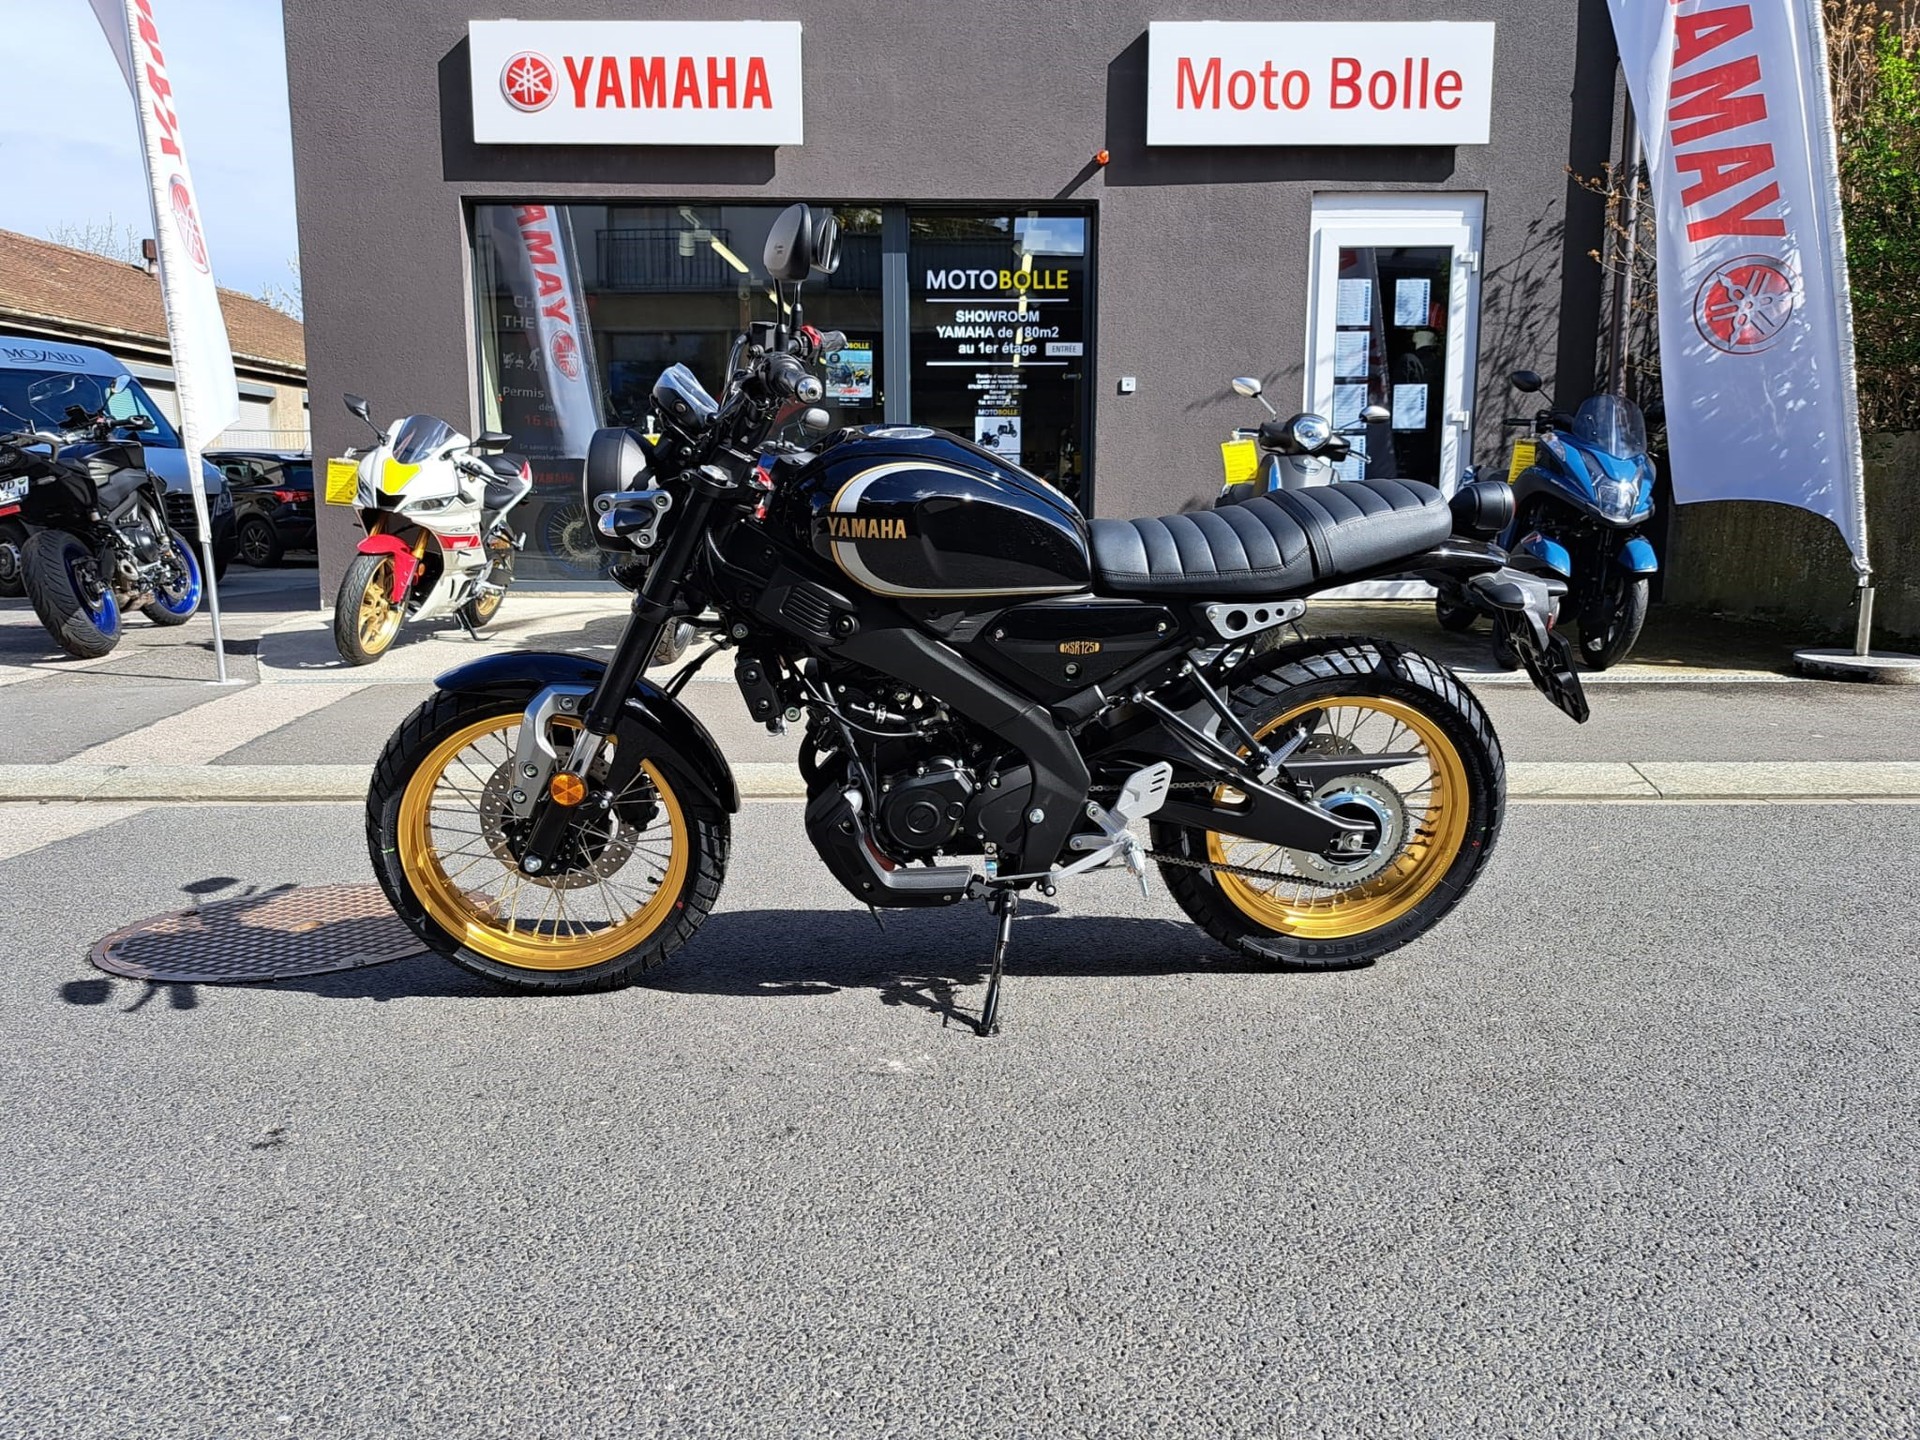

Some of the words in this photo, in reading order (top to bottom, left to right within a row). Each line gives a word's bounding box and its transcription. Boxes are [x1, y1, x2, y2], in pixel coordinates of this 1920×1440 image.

[563, 55, 773, 109] YAMAHA
[1176, 57, 1310, 110] Moto
[1330, 57, 1463, 110] Bolle
[926, 269, 1069, 290] MOTOBOLLE
[502, 315, 535, 329] THE
[955, 310, 1040, 323] SHOWROOM
[936, 326, 995, 338] YAMAHA
[997, 326, 1014, 338] de
[958, 344, 975, 354] au
[977, 342, 999, 354] 1er
[1001, 342, 1037, 356] étage
[1051, 344, 1078, 354] ENTRÉE
[1, 348, 86, 366] MOYARD
[503, 386, 545, 399] Permis
[525, 414, 541, 426] 16
[827, 516, 907, 539] YAMAHA
[1064, 640, 1096, 655] XSR125
